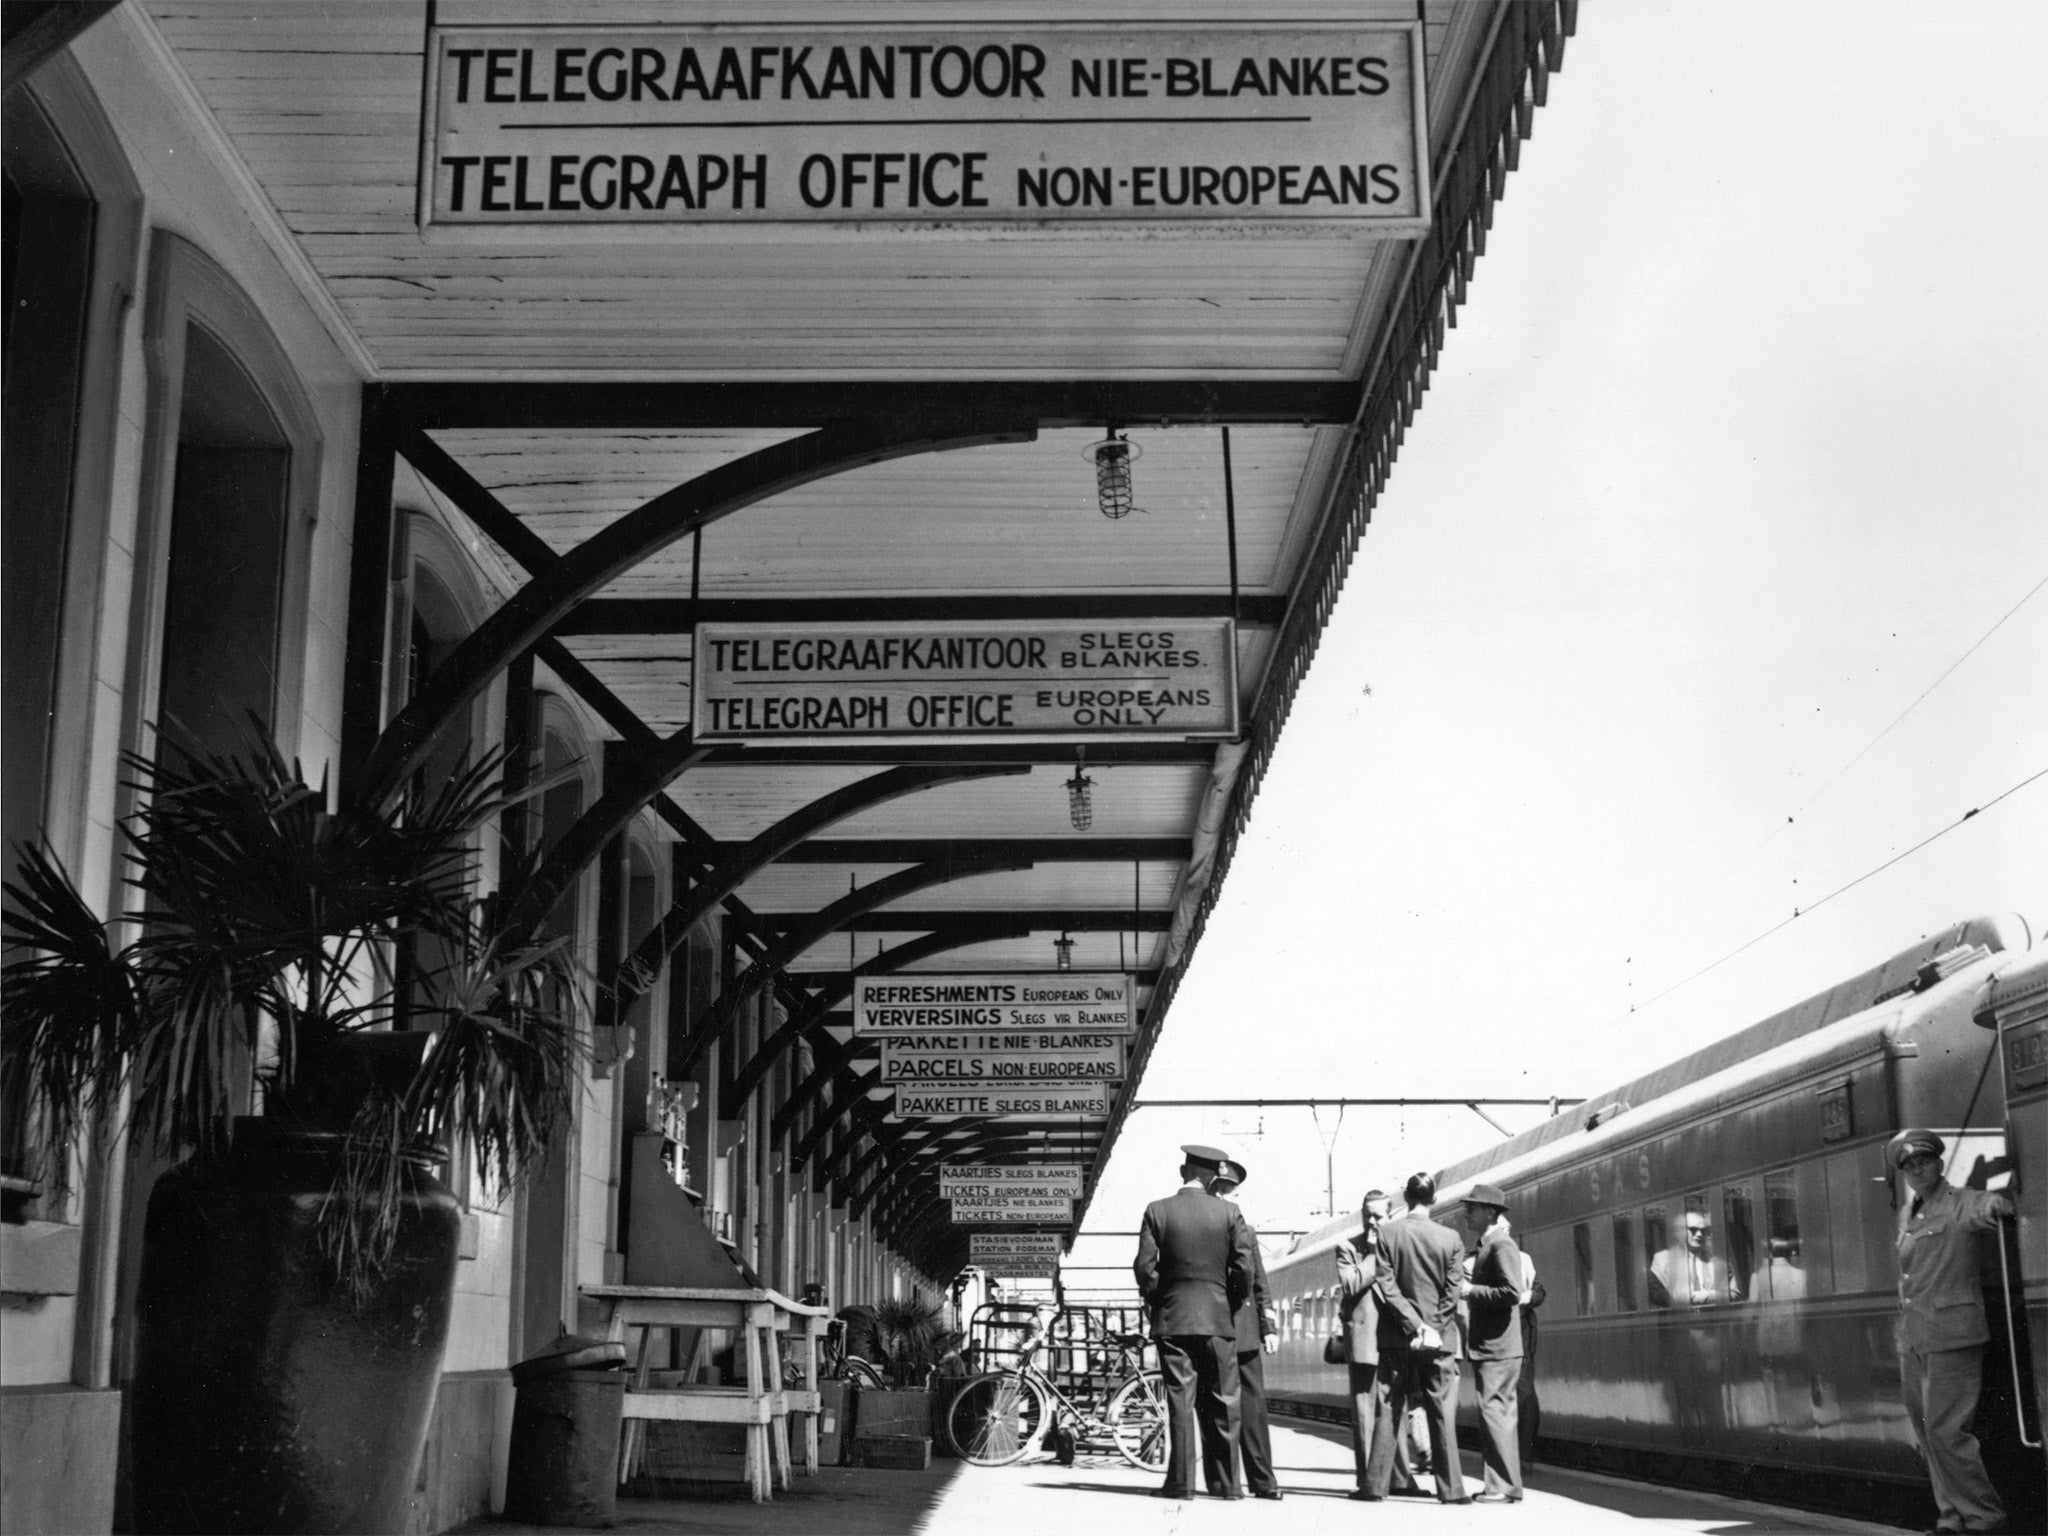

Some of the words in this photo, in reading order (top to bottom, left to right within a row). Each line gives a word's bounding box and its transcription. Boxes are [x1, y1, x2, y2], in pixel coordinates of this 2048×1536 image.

[447, 44, 1046, 103] TELEGRAAFKANTOOR
[1071, 57, 1389, 98] NIE-BLANKES
[440, 154, 767, 212] TELEGRAPH
[799, 152, 988, 209] OFFICE
[1017, 164, 1400, 208] NON-EUROPEANS
[1079, 632, 1174, 650] SLEGS
[709, 638, 1047, 672] TELEGRAAFKANTOOR
[1035, 689, 1210, 708] EUROPEANS
[706, 697, 888, 731] TELEGRAPH
[907, 695, 1013, 729] OFFICE
[1074, 707, 1165, 727] ONLY
[864, 985, 1016, 1003] REFRESHMENTS
[1023, 987, 1089, 1002] EUROPEANS
[1095, 987, 1123, 1001] ONLY
[866, 1008, 1001, 1026] VERVERSINGS
[1010, 1010, 1046, 1025] SLEGS
[1054, 1012, 1071, 1024] VIR
[1078, 1010, 1127, 1024] BLANKES
[888, 1059, 983, 1077] PARCELS
[992, 1061, 1116, 1076] NON-EUROPEANS
[901, 1097, 989, 1113] PAKKETTE
[995, 1100, 1042, 1112] SLEGS
[1045, 1098, 1105, 1112] BLANKES
[942, 1167, 1002, 1178] KAARTJIES
[1005, 1169, 1034, 1178] SLEGS
[1037, 1169, 1077, 1178] BLANKES
[943, 1185, 990, 1196] TICKETS
[994, 1187, 1048, 1196] EUROPEANS
[1053, 1187, 1078, 1196] ONLY
[955, 1199, 1009, 1207] KAARTJIES
[955, 1211, 1003, 1220] TICKETS
[973, 1236, 1054, 1244] STASIEVOORMAN
[973, 1245, 1011, 1253] STATION
